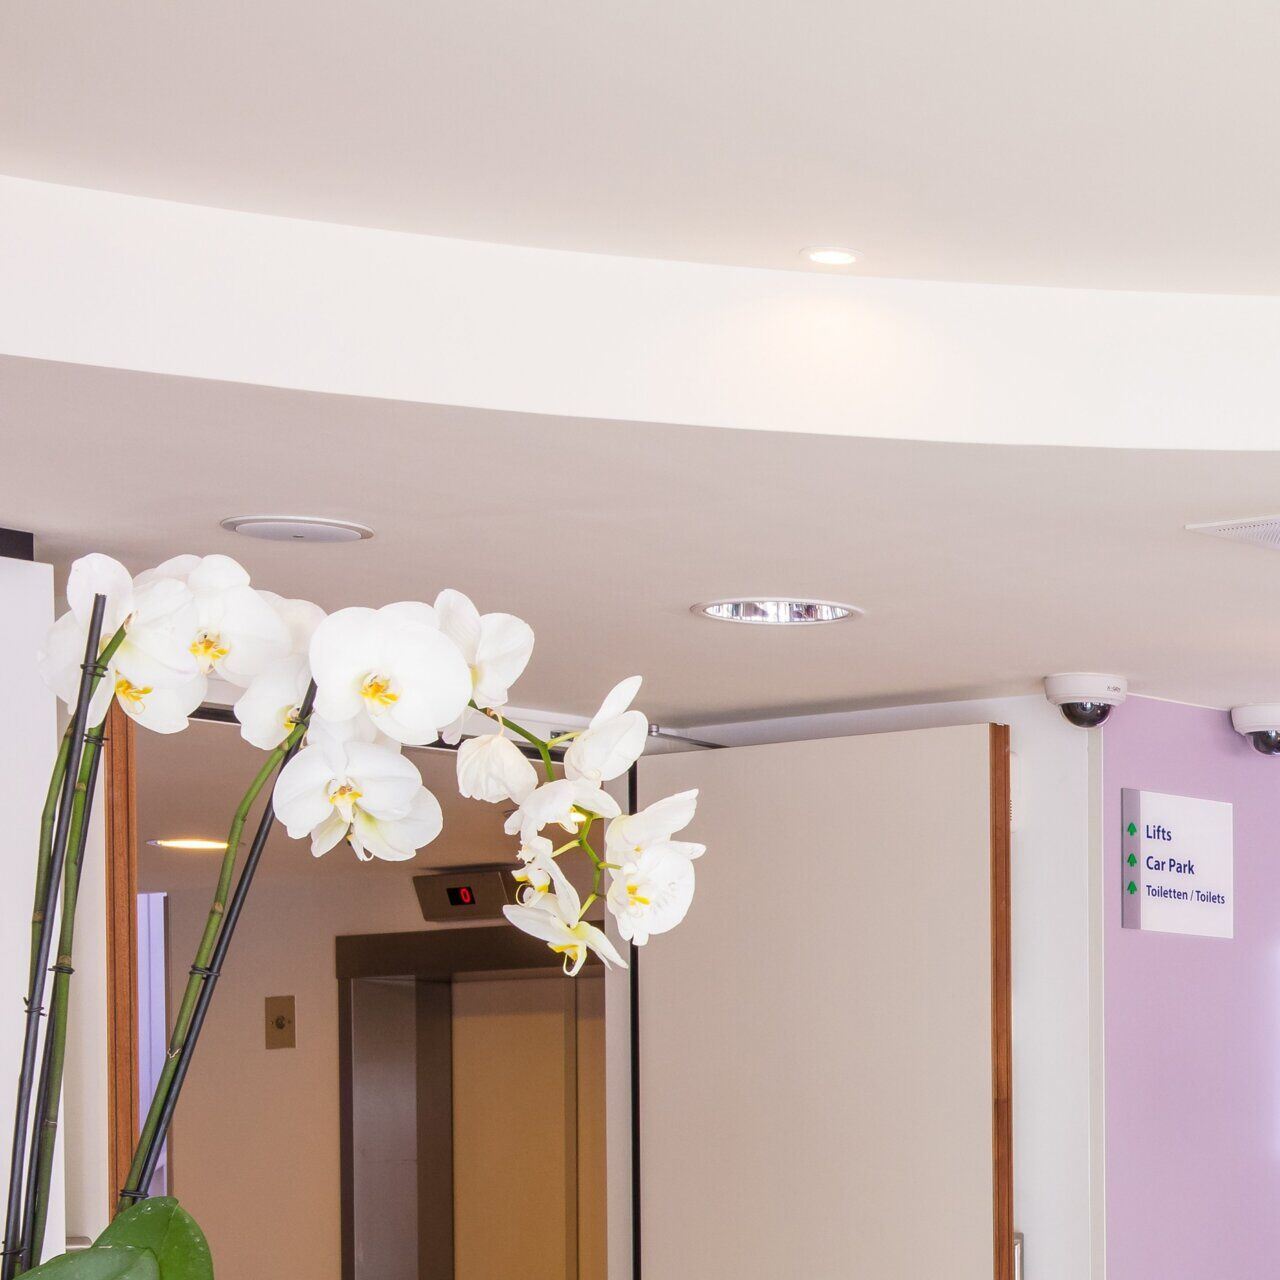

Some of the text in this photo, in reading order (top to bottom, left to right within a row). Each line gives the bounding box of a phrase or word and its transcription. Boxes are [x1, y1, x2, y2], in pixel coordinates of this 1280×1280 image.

[1146, 825, 1172, 841] Lifts
[1146, 856, 1195, 875] Car Park
[1146, 885, 1188, 900] Toiletten
[1195, 890, 1225, 904] Toilets
